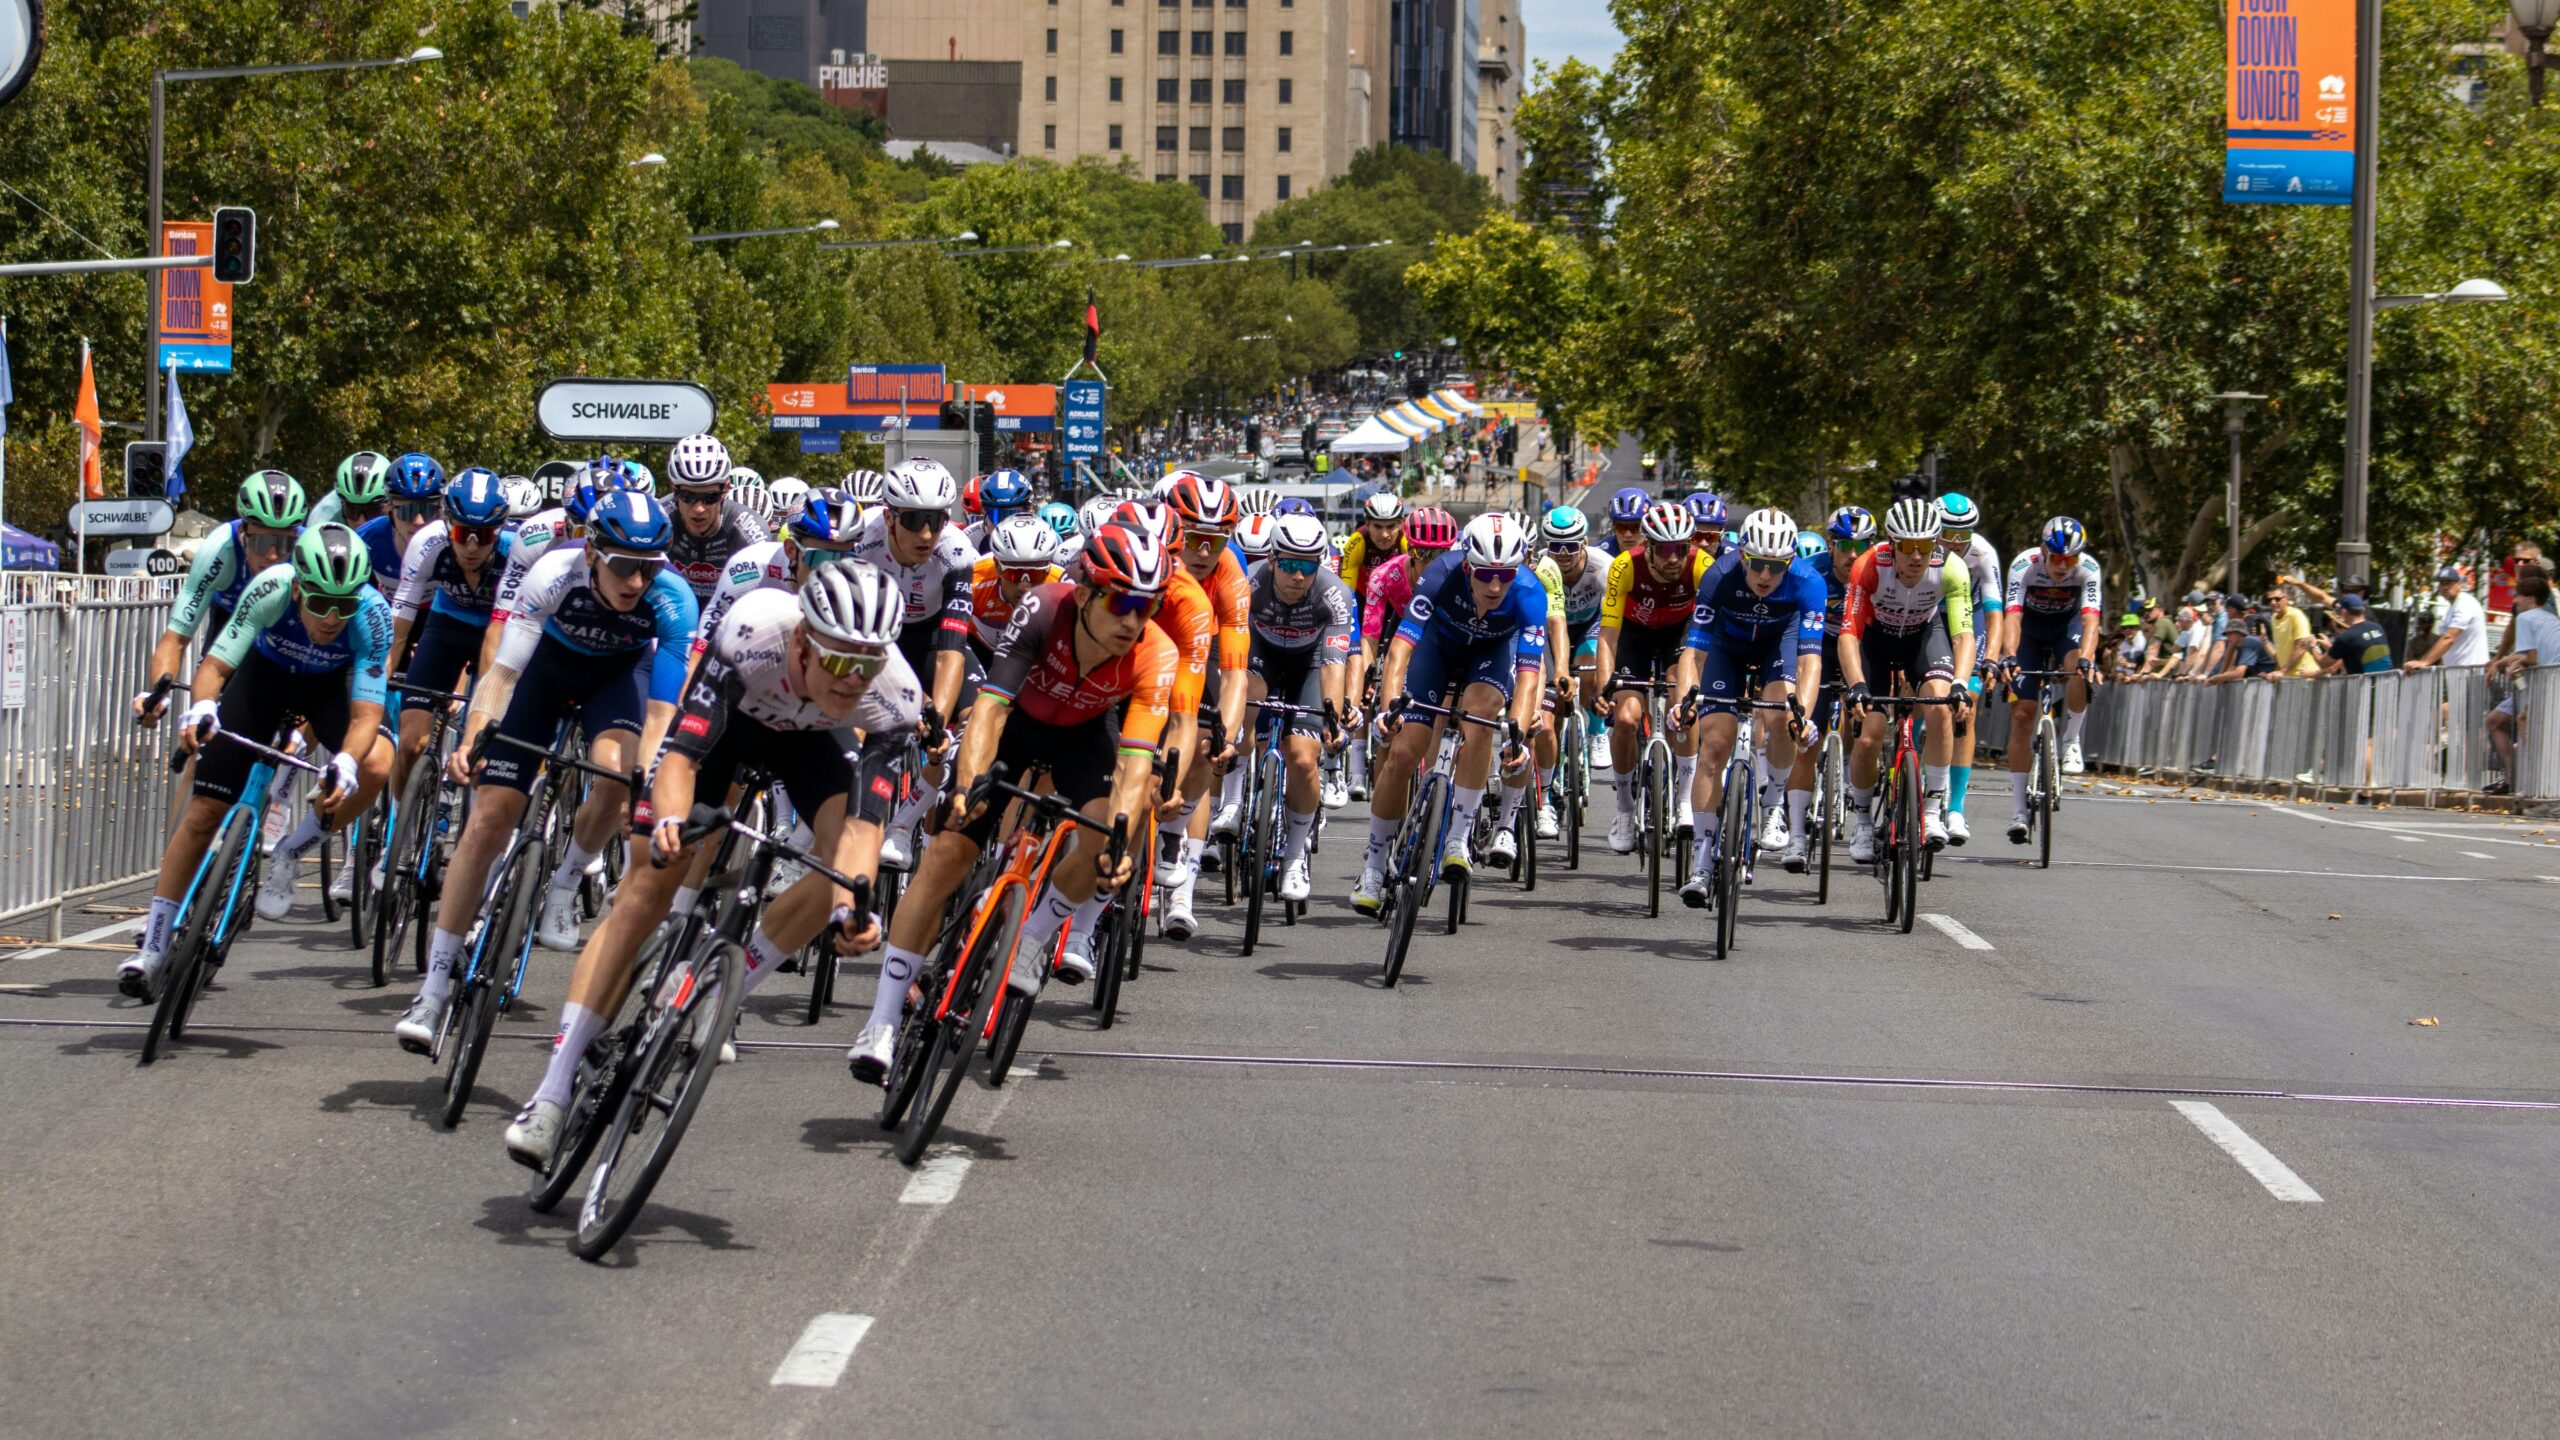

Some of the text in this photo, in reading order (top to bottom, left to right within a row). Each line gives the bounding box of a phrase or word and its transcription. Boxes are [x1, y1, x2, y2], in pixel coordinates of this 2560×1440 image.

[2237, 16, 2297, 67] DOWN
[2237, 70, 2300, 121] UNDER
[169, 231, 197, 239] Santos
[168, 269, 201, 298] DOWN
[167, 300, 202, 329] UNDER
[852, 374, 876, 400] TOUR
[910, 374, 941, 400] UNDER
[572, 402, 670, 420] SCHWALBE
[1068, 443, 1099, 452] Santos
[537, 476, 564, 500] 15
[88, 512, 149, 523] SCHWALBE
[519, 523, 549, 539] BORA
[736, 511, 768, 545] Alpeci
[149, 557, 175, 573] 100
[729, 561, 759, 577] BORA
[189, 557, 224, 609] DECATHLON
[501, 562, 527, 601] BOSS
[1605, 559, 1629, 608] Cofidis
[2087, 580, 2097, 603] BOSS
[236, 579, 280, 627] DECATHLON
[814, 583, 833, 615] MET
[1323, 585, 1351, 625] Alpecin
[364, 607, 386, 663] MONDIALE
[994, 591, 1041, 660] INEOS
[1190, 612, 1211, 675] INEOS
[1046, 652, 1068, 676] GOBIK
[1150, 650, 1179, 718] INEOS
[430, 712, 444, 750] FACTOR
[487, 768, 519, 781] CHANGE
[489, 760, 519, 770] RACING
